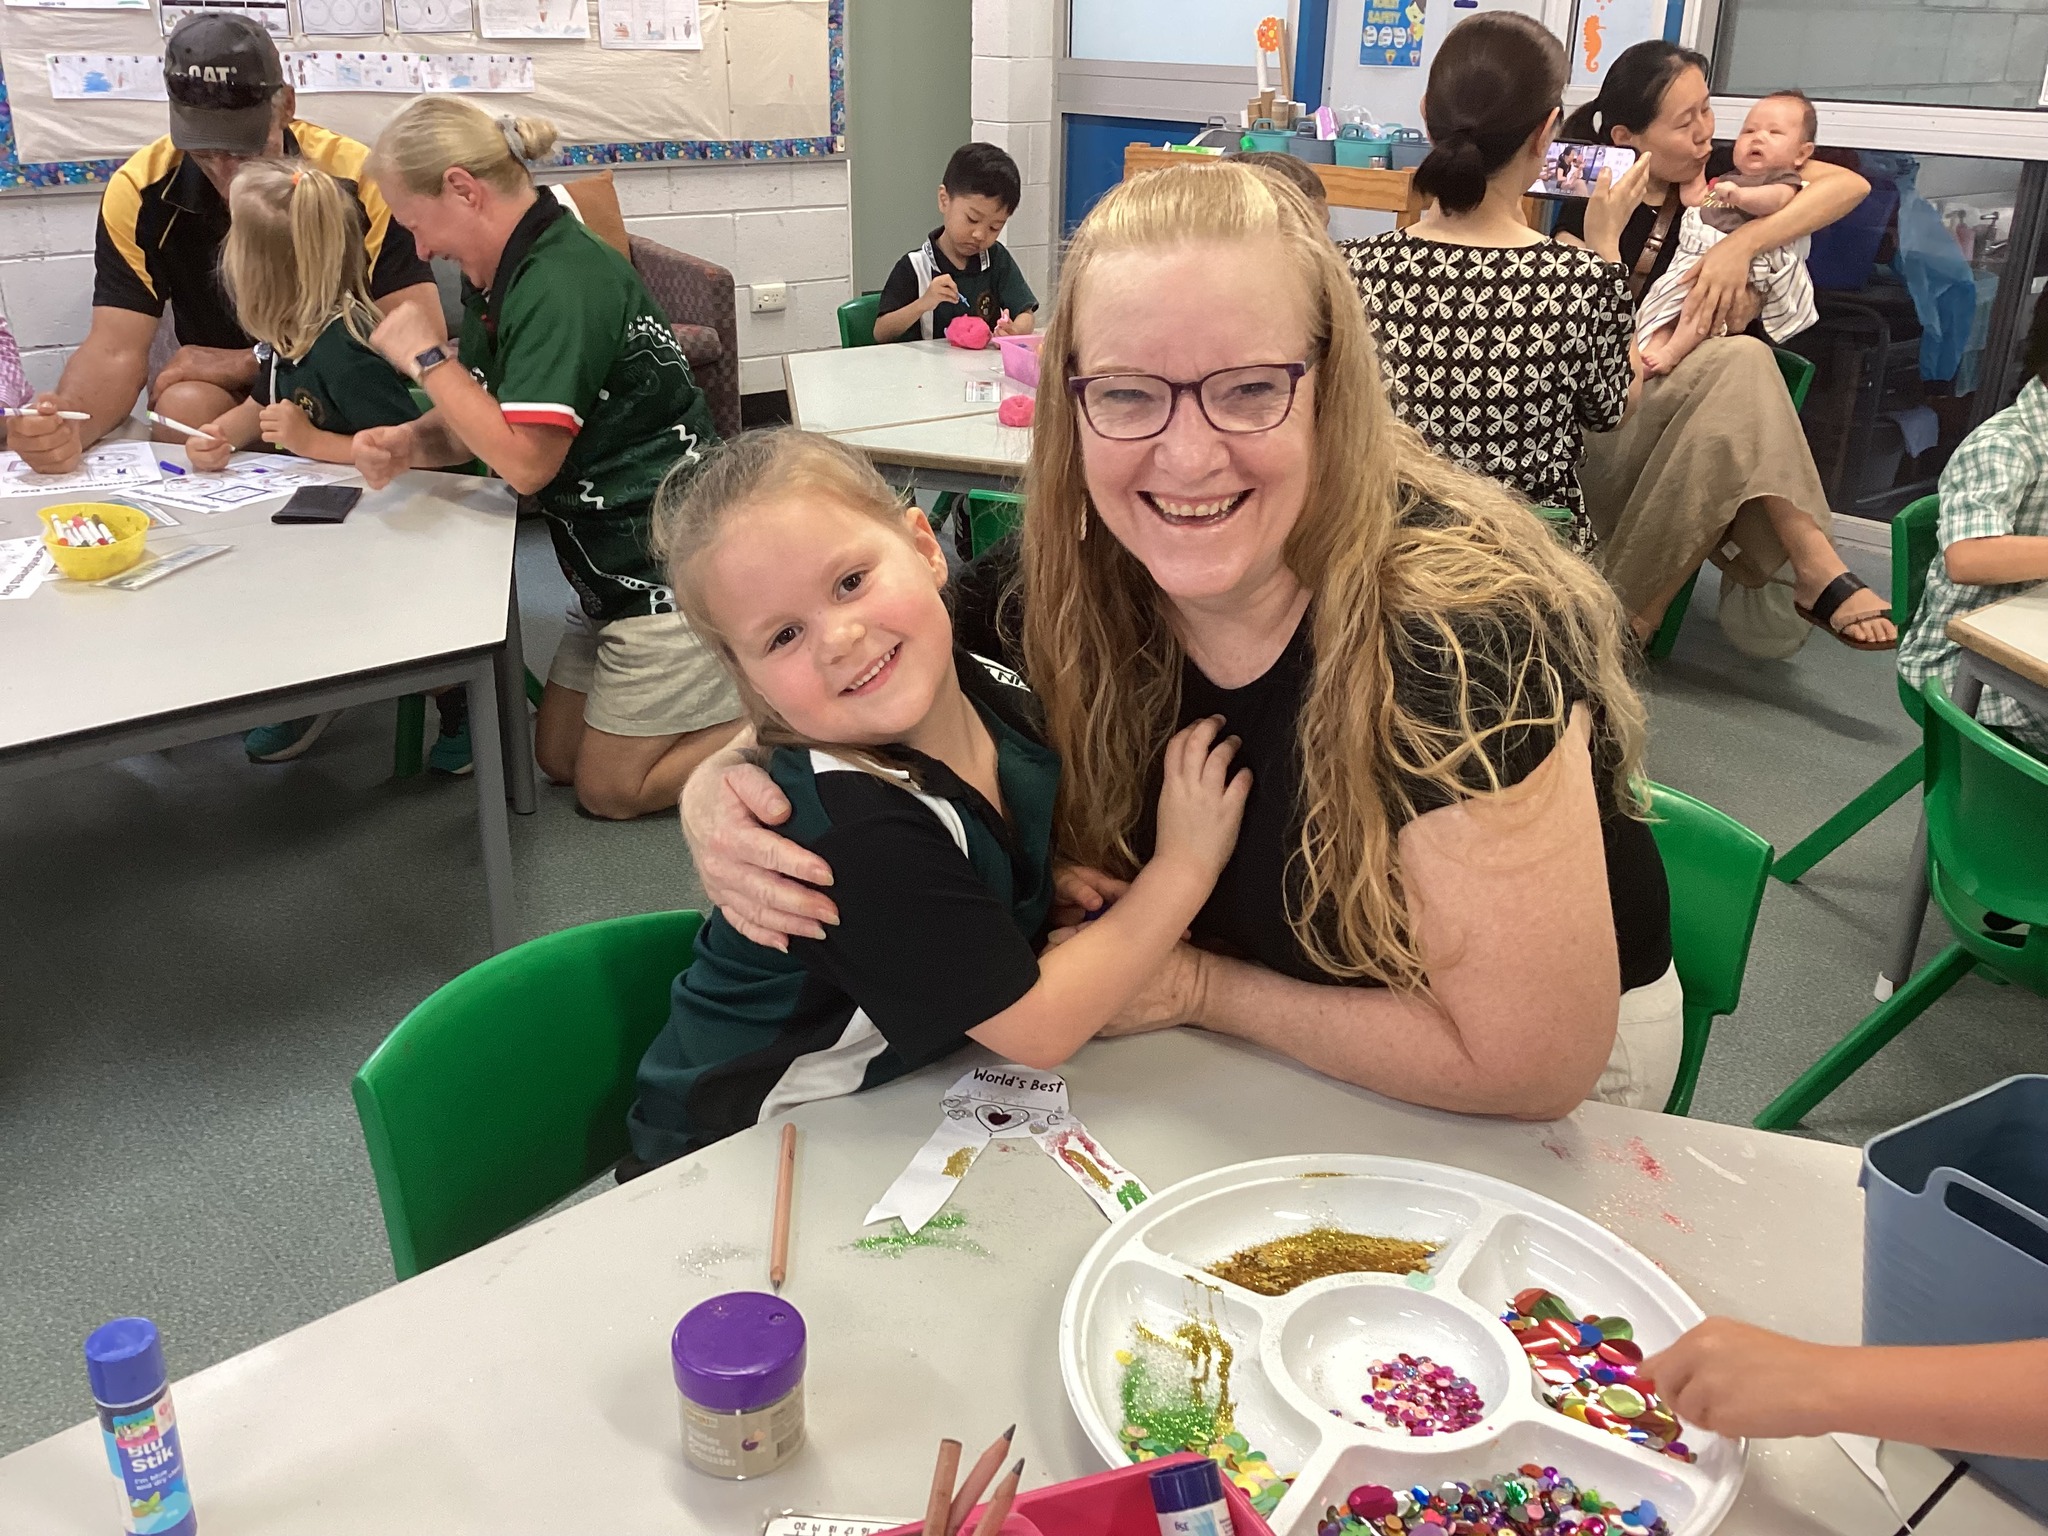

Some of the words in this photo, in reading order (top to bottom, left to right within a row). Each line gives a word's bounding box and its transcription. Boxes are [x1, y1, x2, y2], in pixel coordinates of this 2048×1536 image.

[973, 1067, 1027, 1089] World's
[1030, 1079, 1064, 1093] Best
[131, 1446, 174, 1472] Stik
[793, 1521, 807, 1531] 20
[811, 1523, 821, 1532] 19
[828, 1525, 837, 1533] 18
